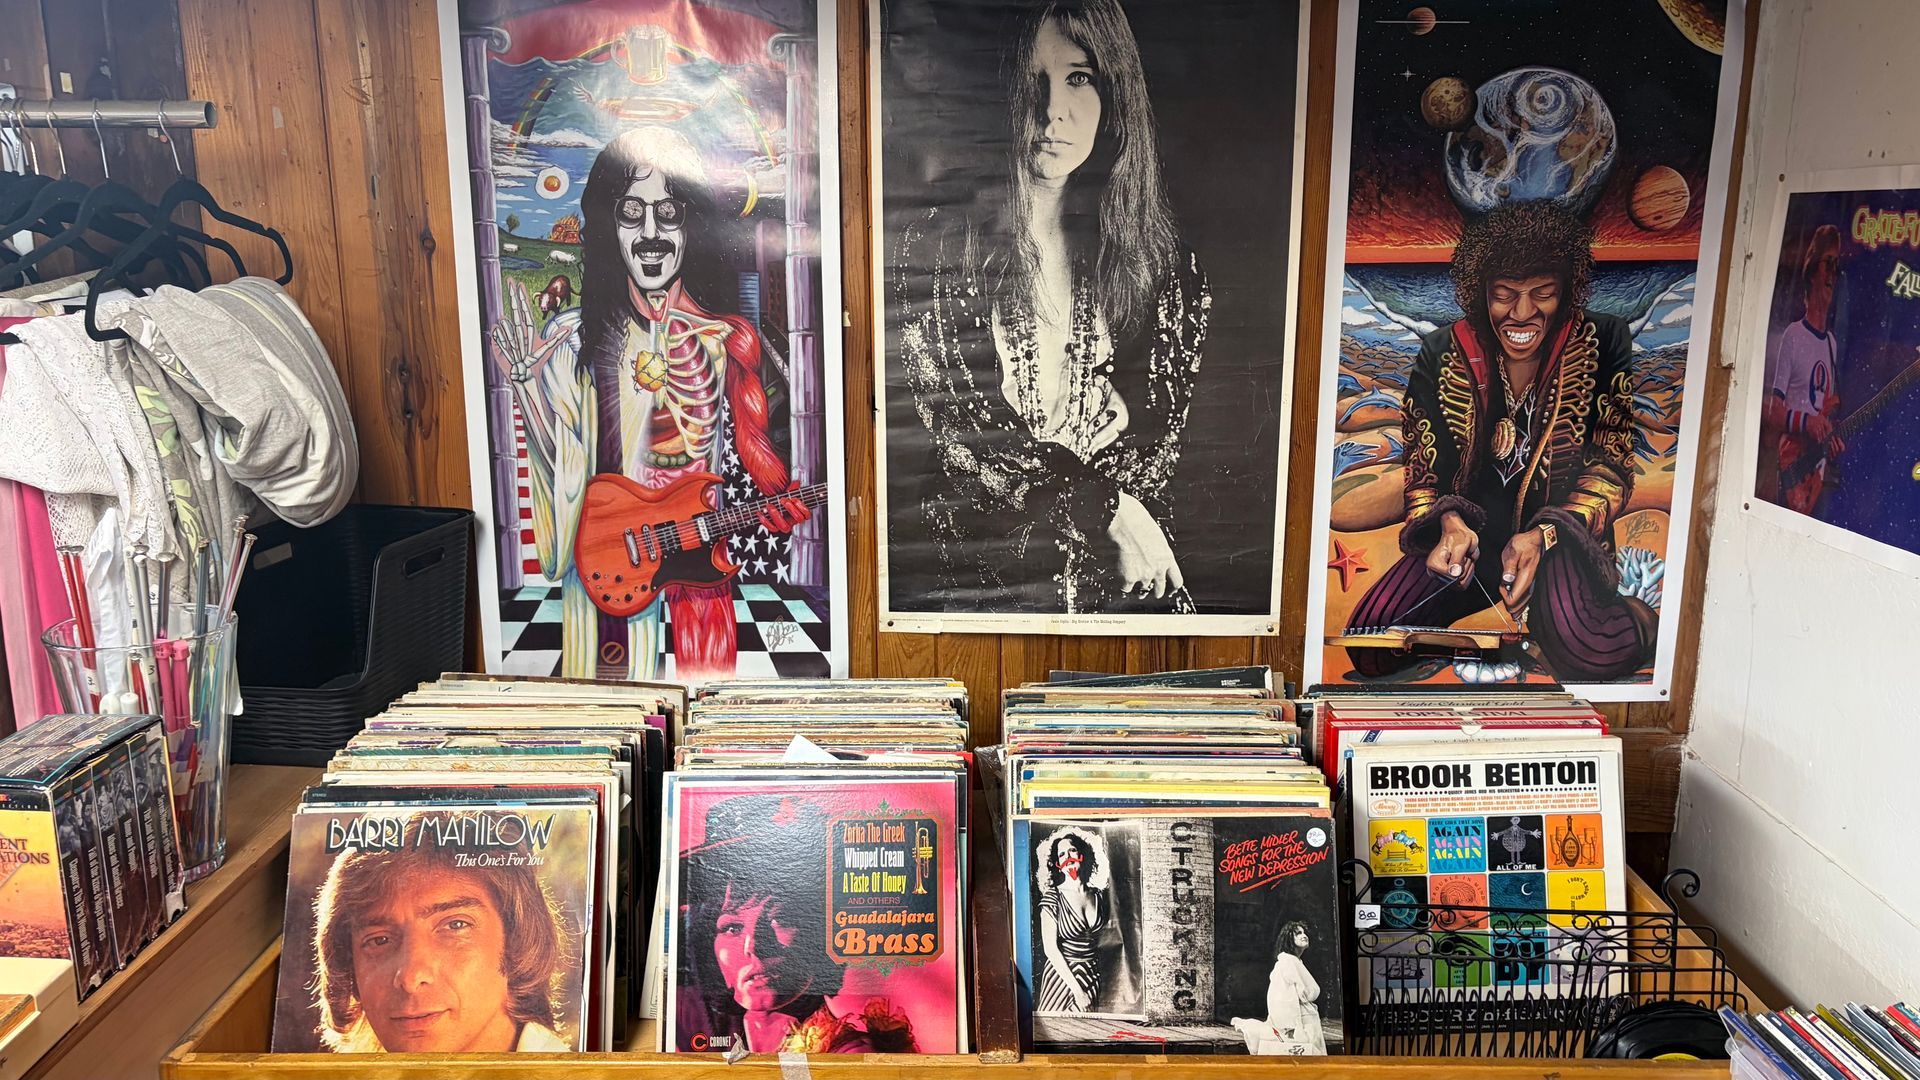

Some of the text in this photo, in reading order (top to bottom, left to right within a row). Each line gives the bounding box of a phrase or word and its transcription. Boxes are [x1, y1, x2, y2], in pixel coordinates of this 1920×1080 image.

[1370, 764, 1472, 790] BROOK
[1484, 760, 1597, 788] BENTON
[327, 814, 556, 852] BARRY MANILOW
[843, 822, 906, 844] Zorba The Greek
[1432, 826, 1481, 837] AGAIN
[126, 836, 135, 849] and
[1224, 840, 1258, 859] BETTE
[1260, 830, 1298, 849] MIDLER
[1432, 837, 1482, 848] AGAIN
[110, 853, 119, 867] and
[454, 853, 544, 867] This One's For You
[845, 847, 905, 870] Whipped Cream
[1219, 841, 1308, 873] SONGS FOR THE
[1432, 848, 1482, 860] AGAIN
[1230, 846, 1329, 885] NEW DEPRESSION
[843, 872, 906, 894] A Taste Of Honey
[74, 888, 84, 905] The
[867, 896, 901, 905] OTHERS
[835, 911, 935, 927] Guadalajara
[834, 928, 935, 955] Brass
[710, 1036, 731, 1047] CORONET
